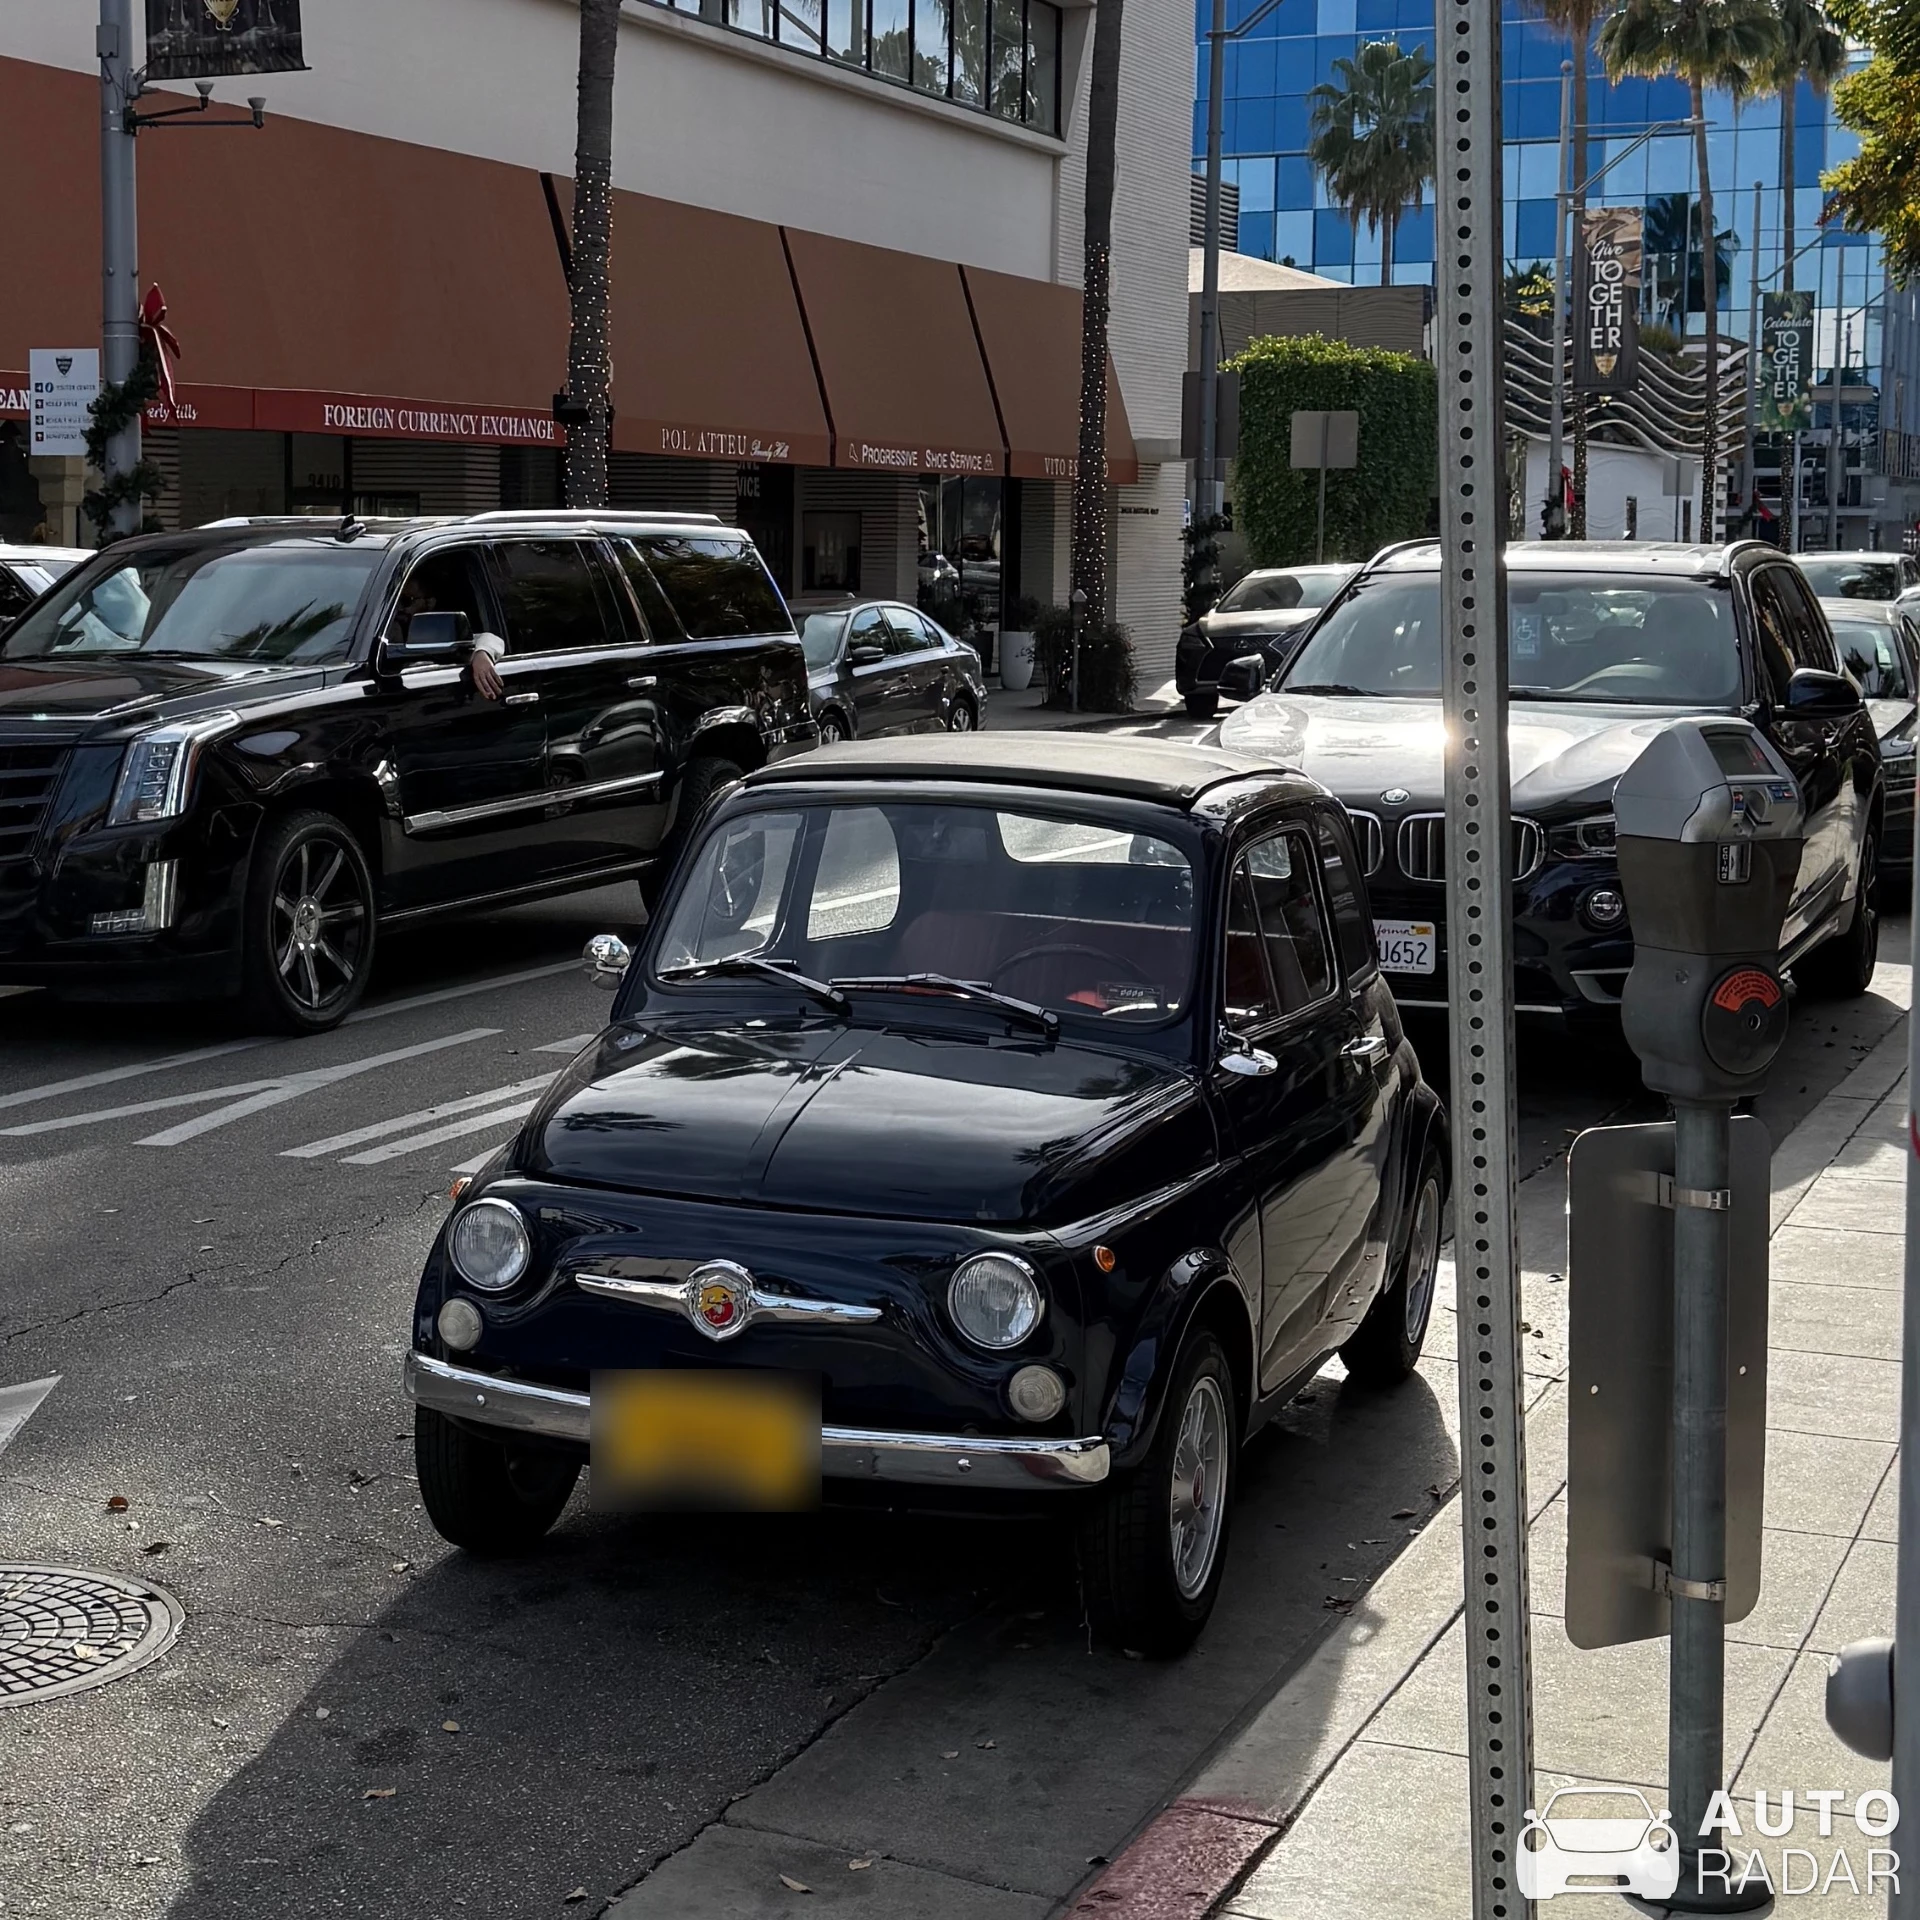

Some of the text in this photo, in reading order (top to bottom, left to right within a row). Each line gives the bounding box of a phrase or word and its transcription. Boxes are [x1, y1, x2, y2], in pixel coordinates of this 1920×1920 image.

[1590, 239, 1624, 260] Give
[1590, 260, 1623, 282] TO
[1589, 283, 1623, 305] GE
[1590, 305, 1622, 327] TH
[1763, 316, 1813, 330] Celebrate
[1590, 328, 1622, 349] ER
[1774, 330, 1800, 347] TO
[1773, 348, 1799, 365] GE
[1774, 365, 1799, 381] TH
[1774, 382, 1798, 398] ER
[147, 403, 170, 422] erly
[323, 404, 555, 440] FOREIGN CURRENCY EXCHANGE
[698, 432, 747, 456] ATTEU
[861, 444, 982, 471] PROGRESSIVE SHOE SERVICE
[1378, 939, 1428, 965] U652
